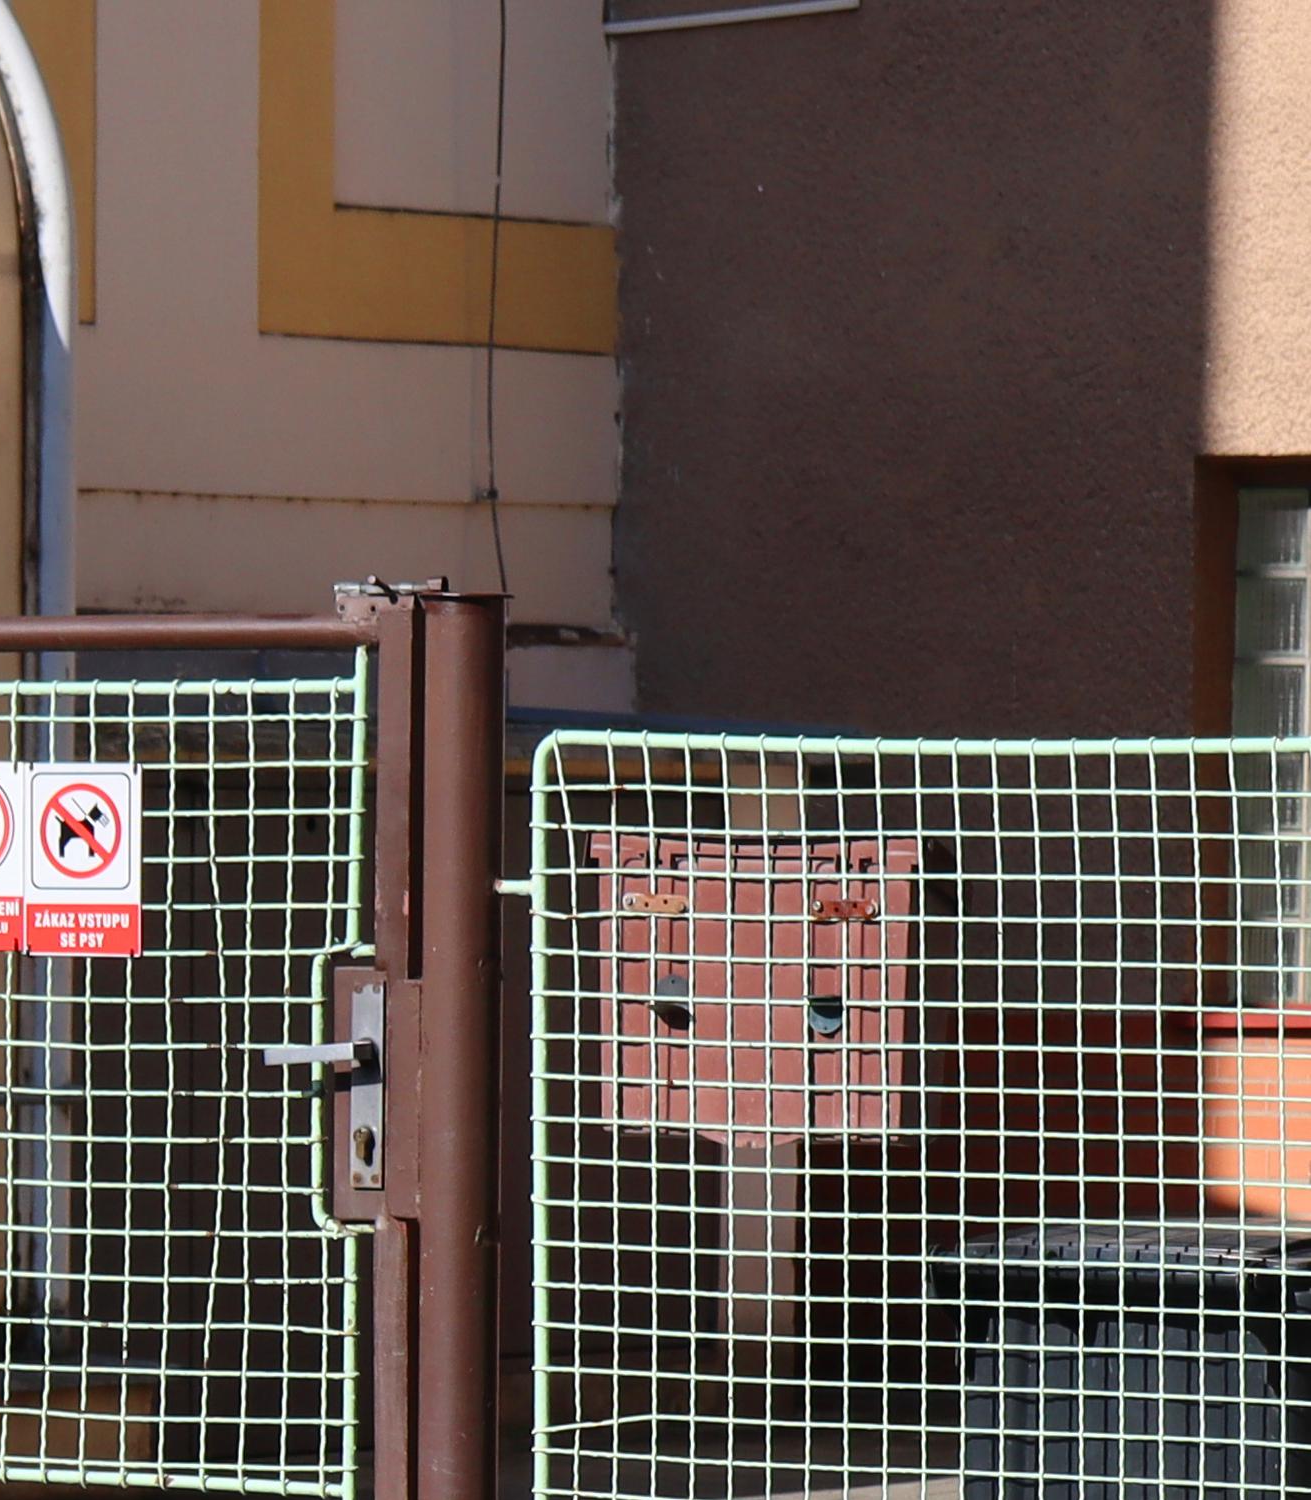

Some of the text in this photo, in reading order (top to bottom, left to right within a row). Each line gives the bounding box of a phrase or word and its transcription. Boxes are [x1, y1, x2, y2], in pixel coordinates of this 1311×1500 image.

[34, 909, 130, 929] ZÁKAZ VSTUPU
[60, 931, 104, 948] SE PSY
